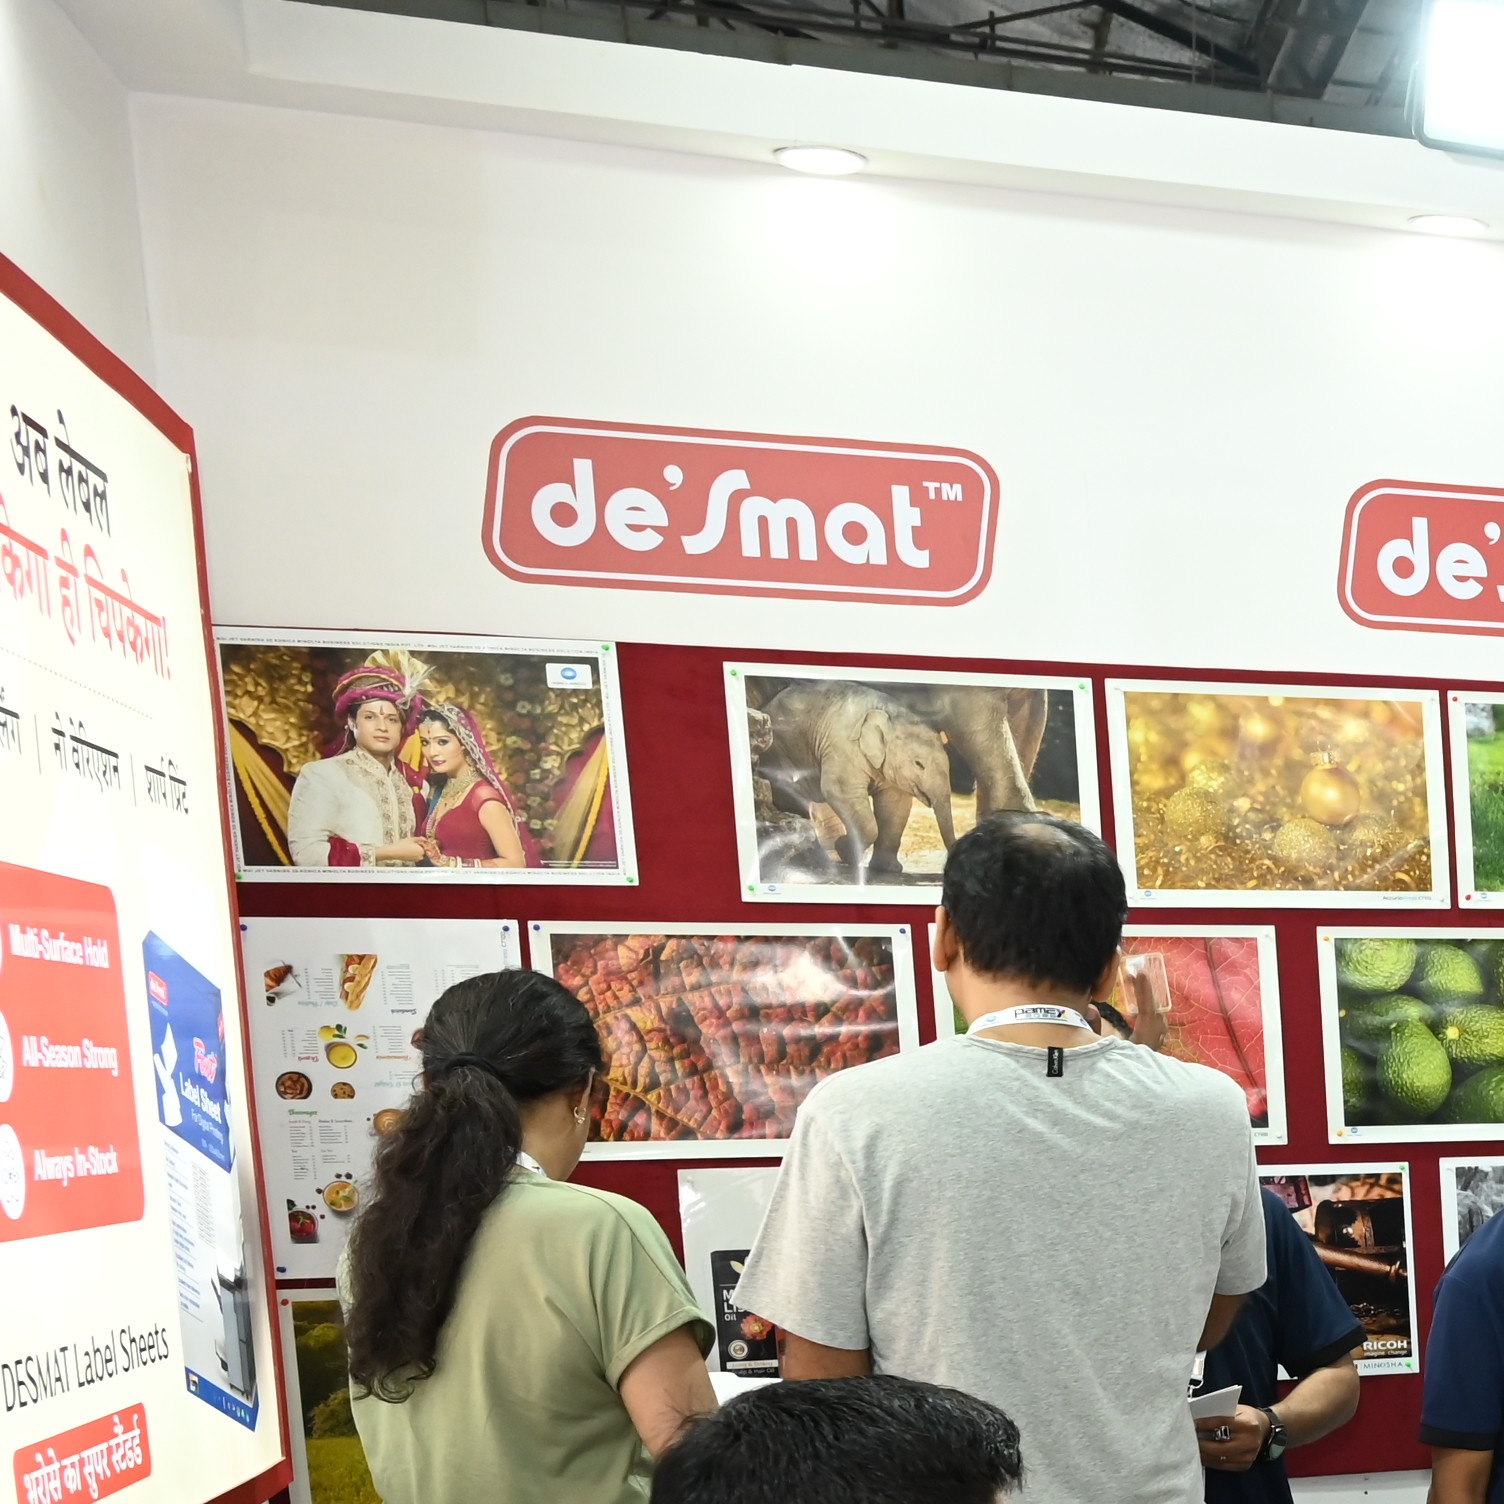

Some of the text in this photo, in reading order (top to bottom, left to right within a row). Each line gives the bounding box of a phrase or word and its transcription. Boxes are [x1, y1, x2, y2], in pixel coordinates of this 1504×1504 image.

[10, 404, 110, 537] अब लेबल
[54, 527, 82, 646] ही
[9, 923, 110, 969] Multi-Surface Hold
[22, 1035, 118, 1077] All-Season Strong
[34, 1145, 118, 1186] Always In-Stock
[1363, 1340, 1407, 1350] RICOH
[1, 1323, 169, 1412] DESMAT Label Sheets
[61, 1454, 81, 1494] का
